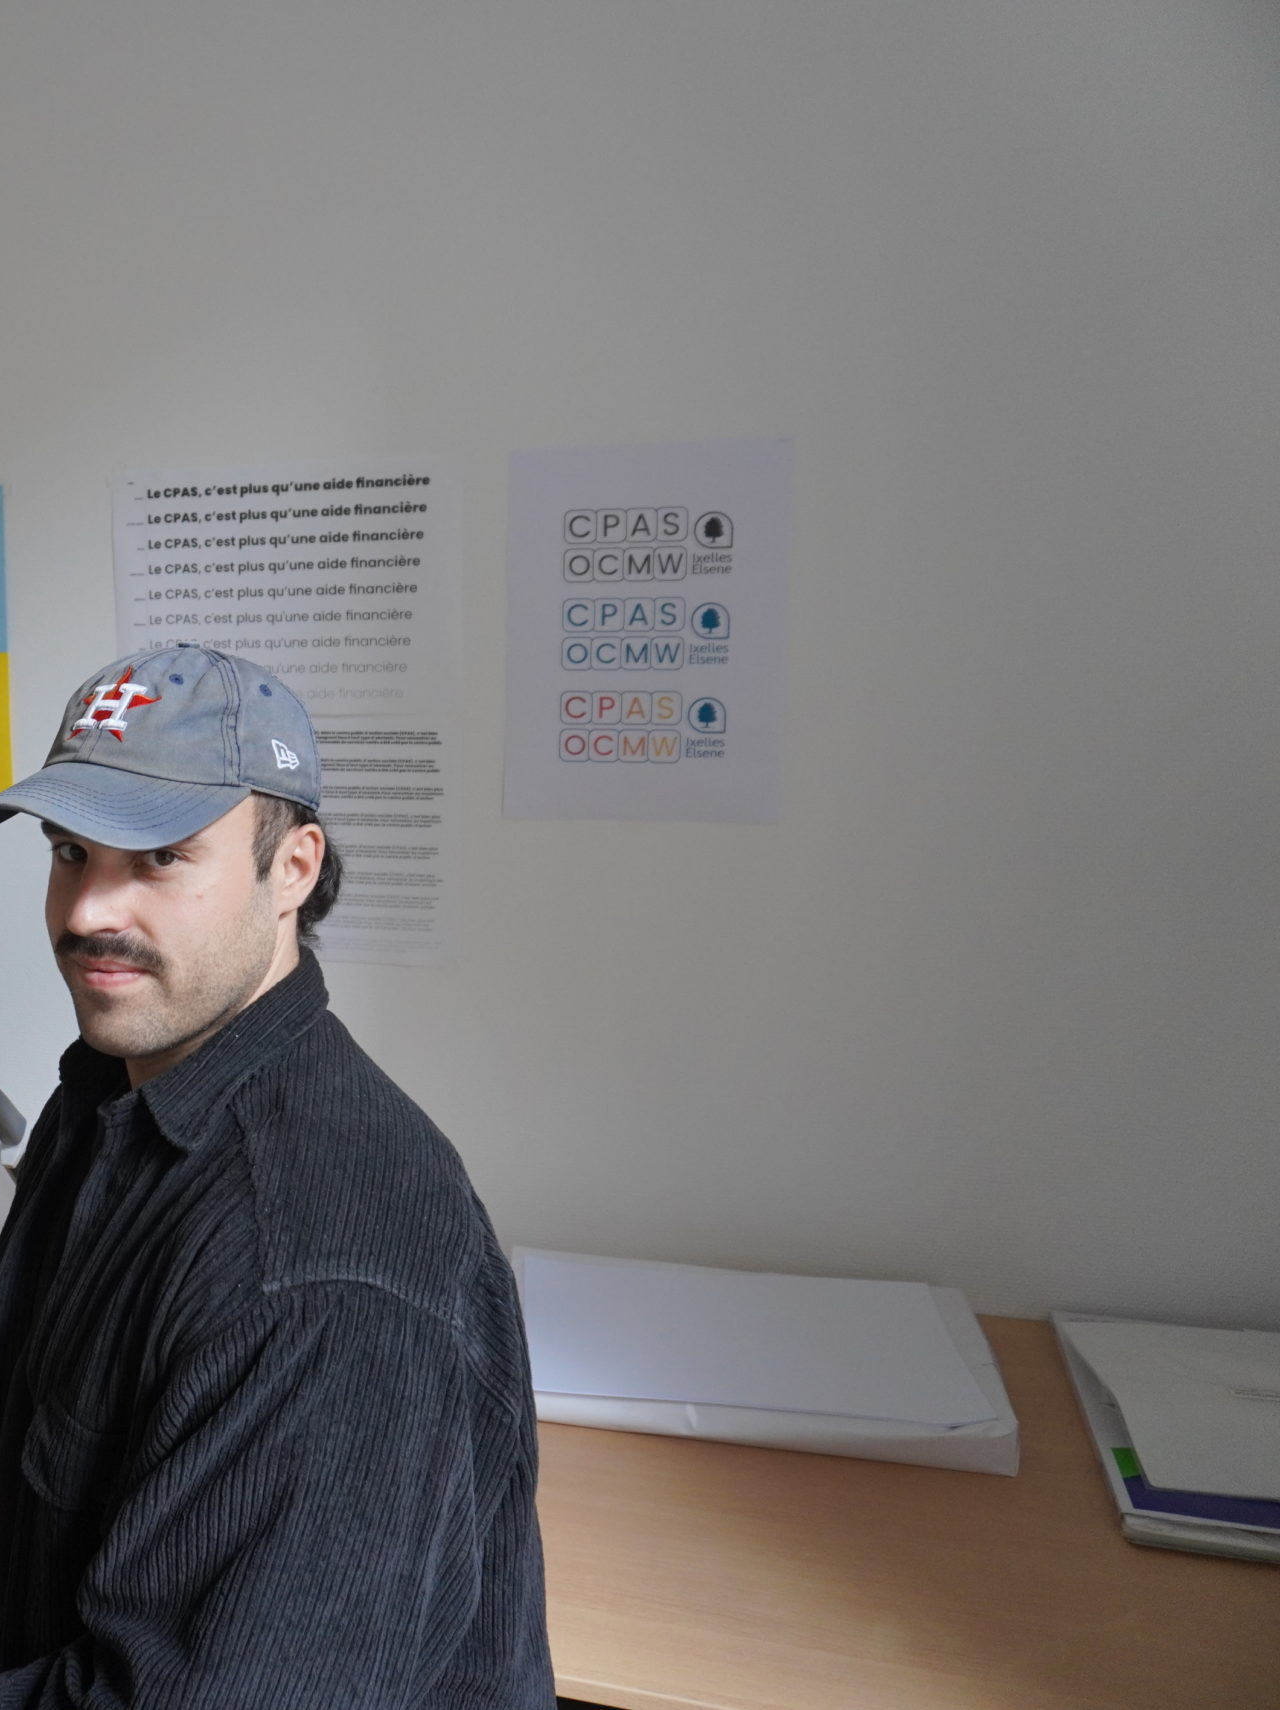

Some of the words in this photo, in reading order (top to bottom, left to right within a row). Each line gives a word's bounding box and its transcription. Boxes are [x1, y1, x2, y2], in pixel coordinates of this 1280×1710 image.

[147, 488, 161, 499] Le
[163, 487, 202, 498] CPAS,
[205, 485, 238, 496] c'est
[240, 482, 269, 498] plus
[271, 481, 321, 497] qu'une
[322, 478, 353, 491] aide
[356, 474, 431, 489] financière
[148, 514, 162, 525] Le
[164, 512, 202, 524] CPAS,
[205, 511, 237, 522] c'est
[239, 509, 268, 524] plus
[270, 507, 319, 523] qu'une
[321, 505, 352, 517] aide
[354, 501, 428, 515] financière
[569, 512, 680, 538] CPAS
[148, 541, 162, 551] Le
[164, 538, 202, 550] CPAS,
[205, 537, 236, 548] c'est
[239, 535, 266, 550] plus
[269, 533, 317, 548] qu'une
[319, 531, 350, 543] aide
[352, 528, 425, 542] financière
[148, 565, 162, 575] Le
[164, 563, 202, 575] CPAS,
[205, 562, 235, 573] c'est
[238, 560, 266, 575] plus
[268, 558, 314, 573] qu'une
[317, 556, 348, 569] aide
[350, 554, 421, 569] financière
[569, 553, 684, 576] OCMW
[692, 552, 733, 564] Ixelles
[692, 563, 733, 575] Elsene
[149, 590, 162, 600] Le
[165, 588, 202, 600] CPAS,
[204, 588, 235, 598] c'est
[237, 586, 265, 600] plus
[267, 584, 313, 599] qu'une
[315, 583, 346, 595] aide
[349, 581, 418, 595] financière
[149, 614, 162, 624] Le
[166, 613, 200, 626] CPAS,
[204, 612, 233, 623] c'est
[236, 610, 263, 625] plus
[266, 609, 309, 624] qu'une
[312, 608, 342, 621] aide
[346, 606, 413, 621] financière
[567, 602, 678, 627] CPAS
[150, 639, 162, 649] Le
[203, 637, 232, 649] c'est
[236, 636, 262, 650] plus
[265, 635, 309, 650] qu'une
[311, 634, 341, 647] aide
[345, 633, 411, 647] financière
[689, 642, 729, 654] Ixelles
[567, 642, 681, 664] OCMW
[689, 653, 729, 664] Elsene
[309, 660, 338, 673] aide
[342, 660, 408, 673] financière
[72, 682, 151, 731] H
[564, 696, 675, 719] CPAS
[564, 735, 678, 757] OCMW
[686, 737, 726, 748] Ixelles
[685, 747, 725, 759] Elsene
